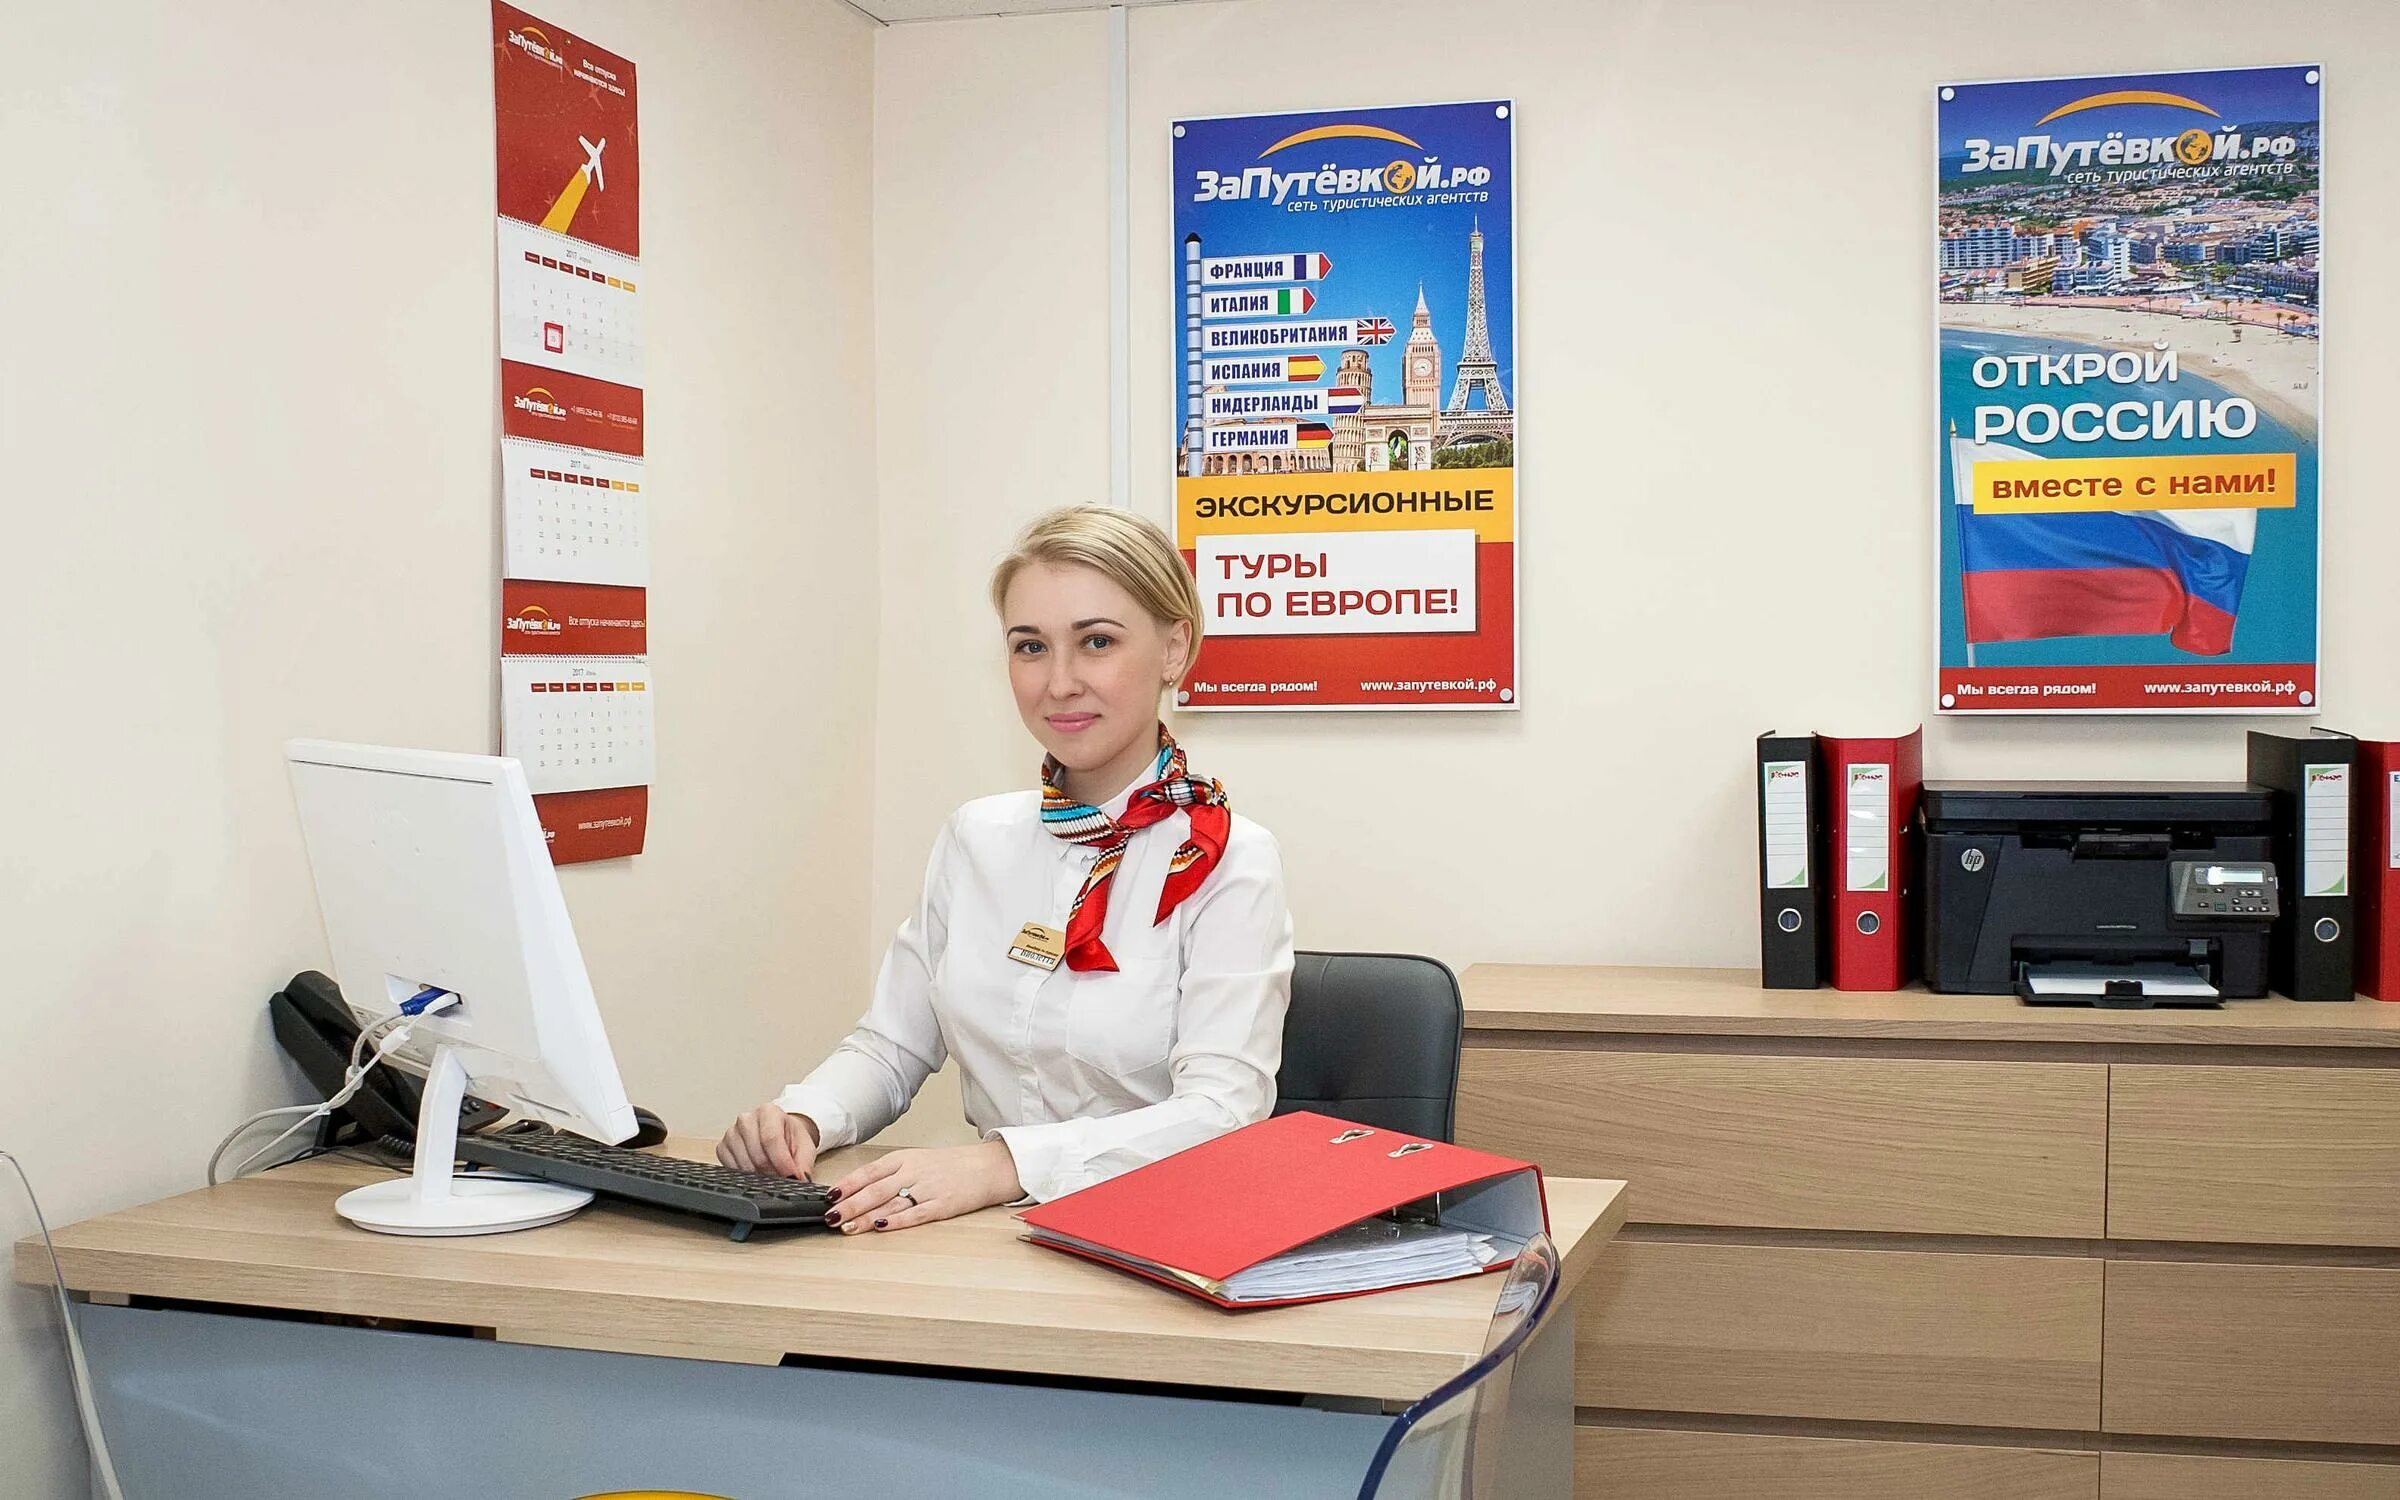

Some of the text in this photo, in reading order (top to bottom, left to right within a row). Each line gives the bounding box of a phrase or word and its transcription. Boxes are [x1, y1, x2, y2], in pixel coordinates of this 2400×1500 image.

[2067, 162, 2294, 184] сеть туристических агентств
[1287, 191, 1489, 213] сеть туристических агентств
[1210, 261, 1284, 280] ФРАНЦИЯ
[1210, 295, 1269, 313] ИТАЛИЯ
[1211, 325, 1348, 347] ВЕЛИКОБРИТАНИЯ
[1211, 362, 1281, 380] ИСПАНИЯ
[1972, 342, 2178, 388] ОТКРОЙ
[1211, 395, 1318, 415] НИДЕРЛАНДЫ
[1974, 397, 2257, 445] РОССИЮ
[1212, 429, 1289, 447] ГЕРМАНИЯ
[1992, 468, 2276, 500] вместе с нами!
[1195, 489, 1495, 518] ЭКСКУРСИОННЫЕ
[1215, 552, 1328, 580] ТУРЫ
[1217, 588, 1458, 618] ПО ЕВРОПЕ!
[1194, 680, 1318, 695] Мы всегда рядом!
[1360, 678, 1497, 694] www.запутевкой.рф
[1957, 682, 2097, 698] Мы всегда рядом!
[2144, 680, 2296, 698] www.запутевкой.рф
[1965, 849, 1981, 871] hp
